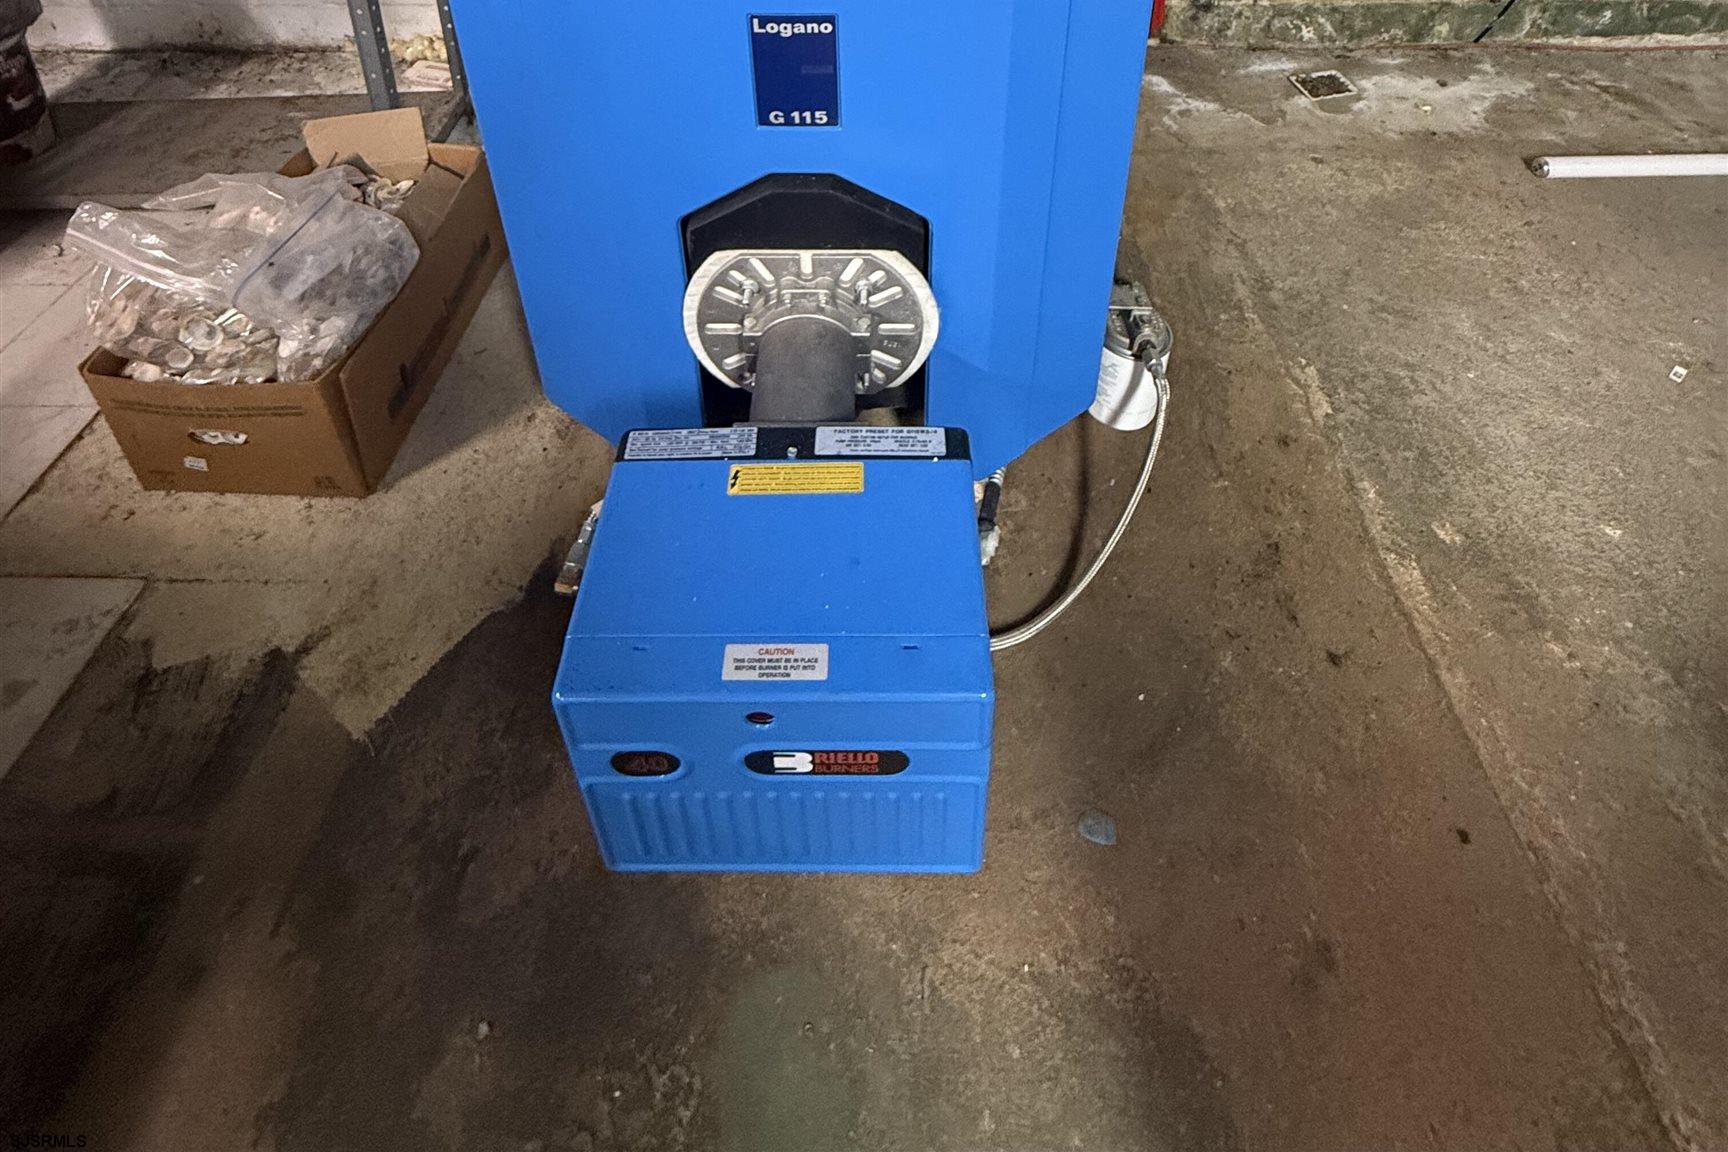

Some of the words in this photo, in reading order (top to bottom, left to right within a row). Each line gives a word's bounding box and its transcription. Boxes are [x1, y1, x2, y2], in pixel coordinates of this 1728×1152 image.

[752, 18, 833, 38] Logano
[768, 110, 785, 124] G
[790, 110, 828, 124] 115
[758, 648, 795, 656] CAUTION
[814, 752, 879, 763] RIELLO
[814, 764, 879, 773] BURNERS
